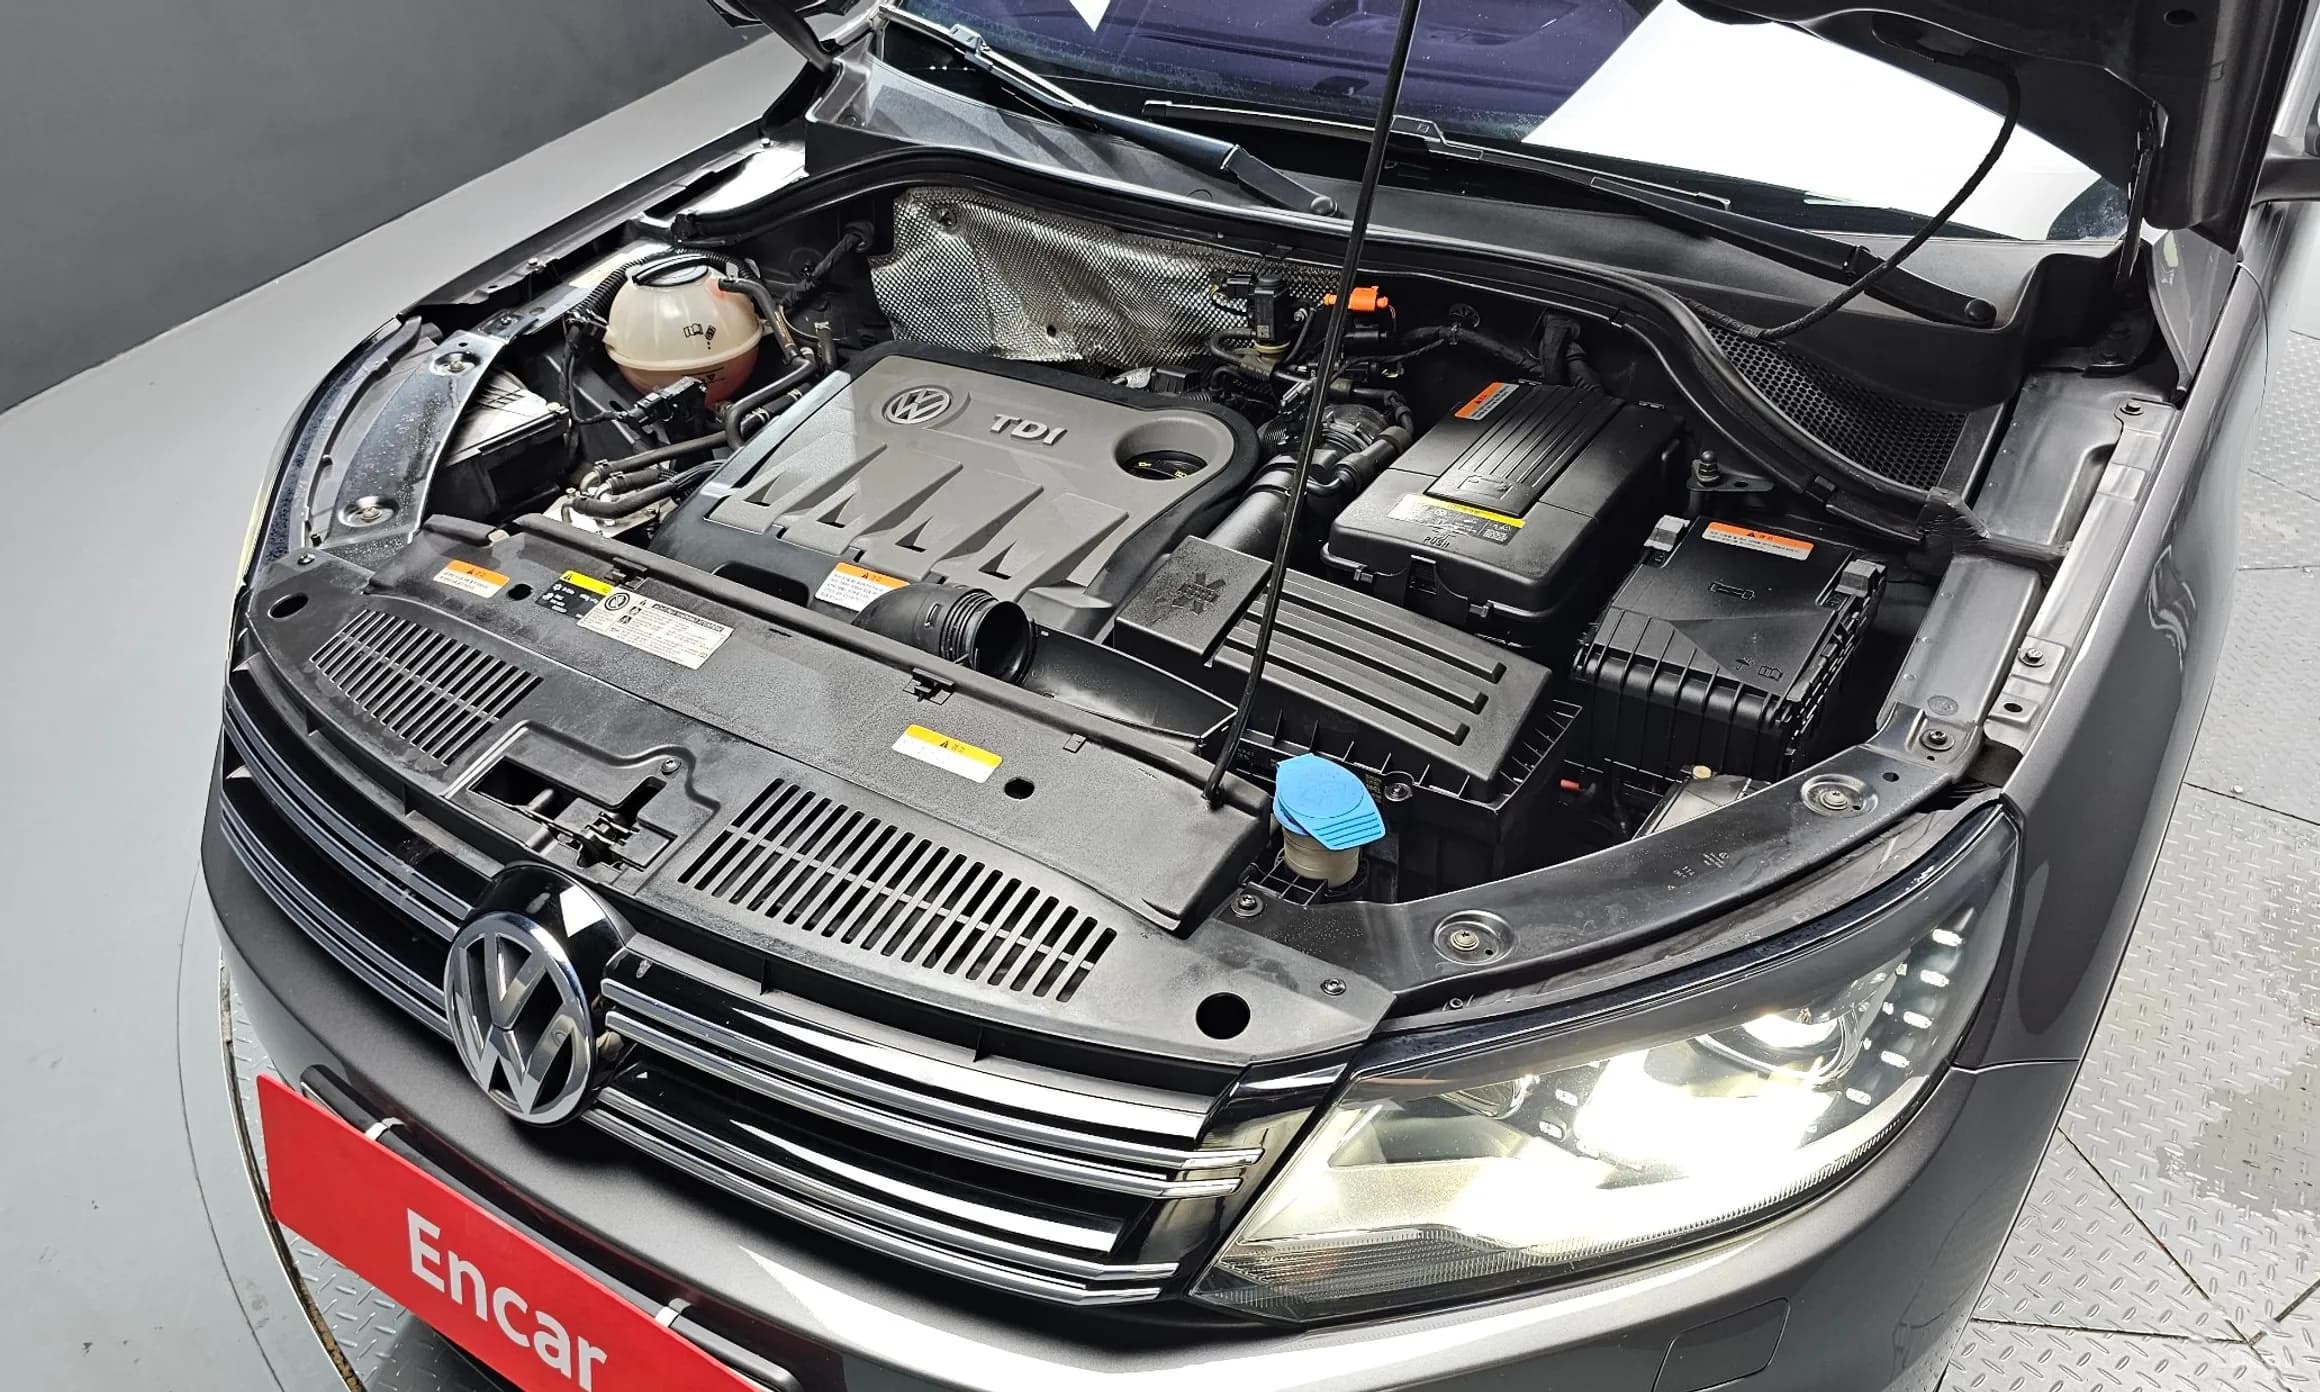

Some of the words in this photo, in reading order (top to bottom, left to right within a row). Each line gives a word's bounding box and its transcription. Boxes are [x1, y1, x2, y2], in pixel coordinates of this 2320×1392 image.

[884, 386, 951, 424] VW
[990, 414, 1068, 446] TDI
[448, 914, 594, 1122] VW
[406, 1208, 608, 1391] Encar
